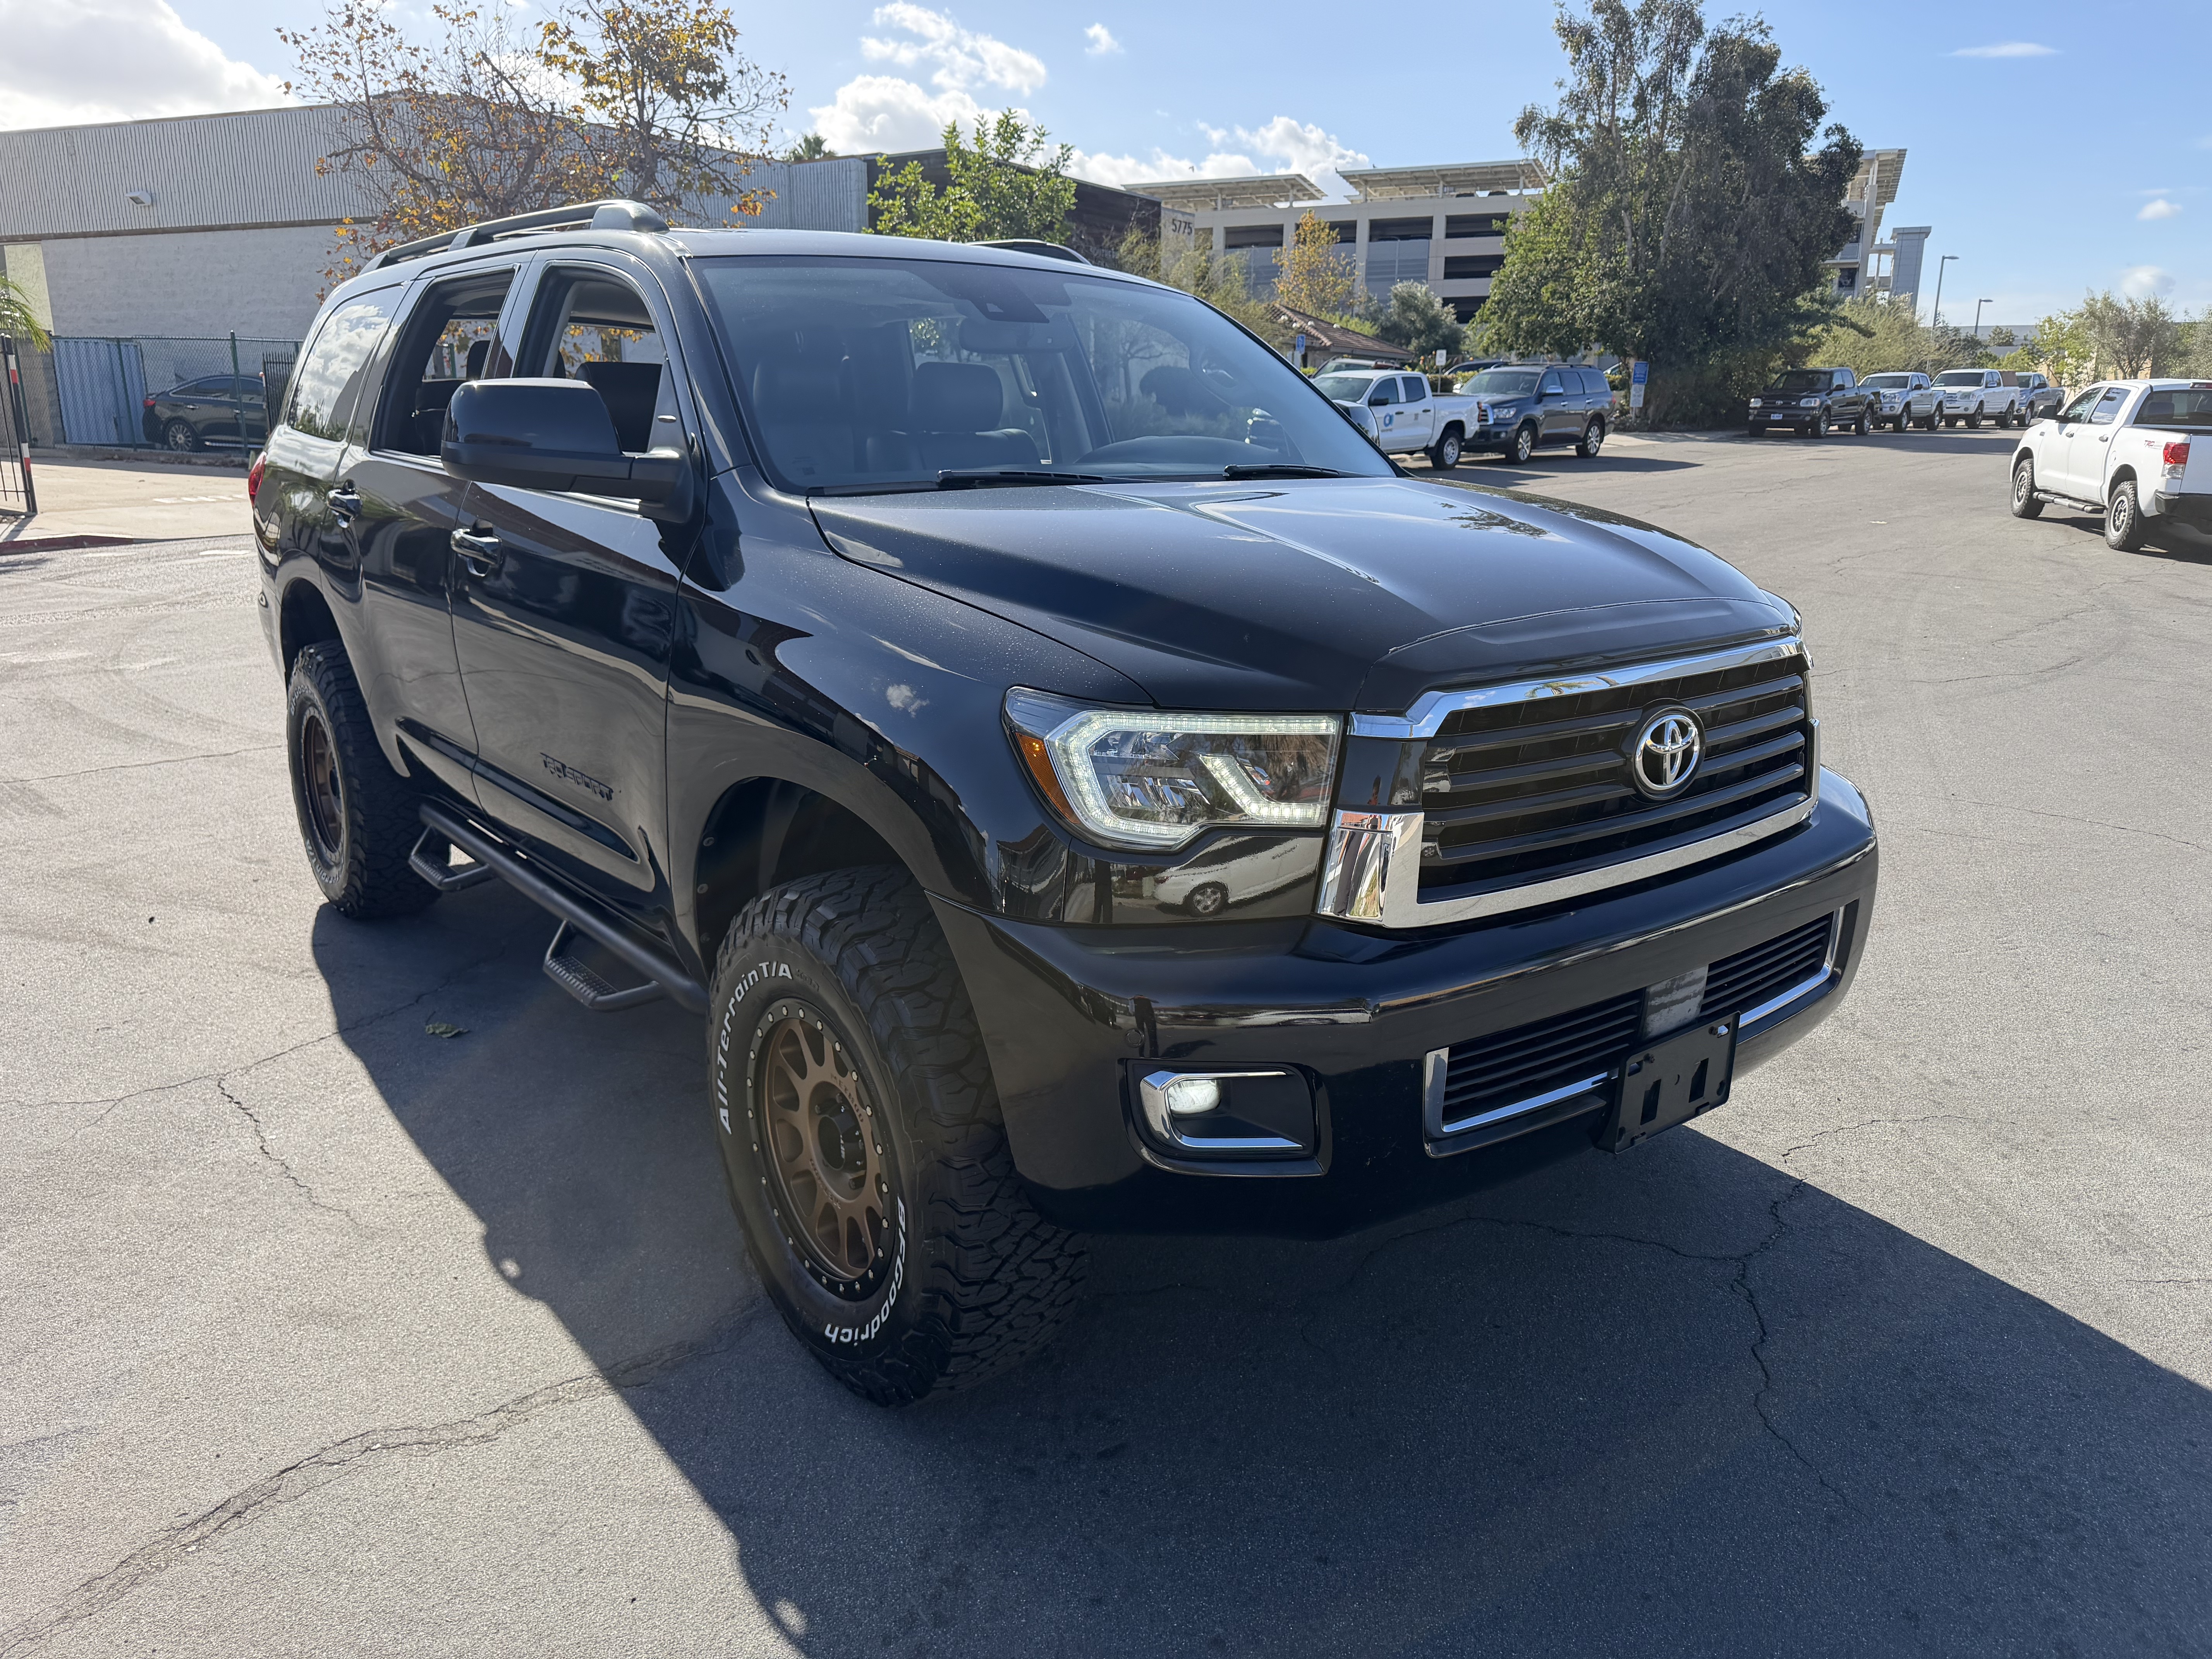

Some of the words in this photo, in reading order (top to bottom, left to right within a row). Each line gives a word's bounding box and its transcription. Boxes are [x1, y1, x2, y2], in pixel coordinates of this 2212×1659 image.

[1172, 218, 1192, 235] 5775
[718, 968, 759, 1135] All-Terrain
[759, 961, 793, 980] T/A
[824, 1195, 905, 1346] BFGoodrich
